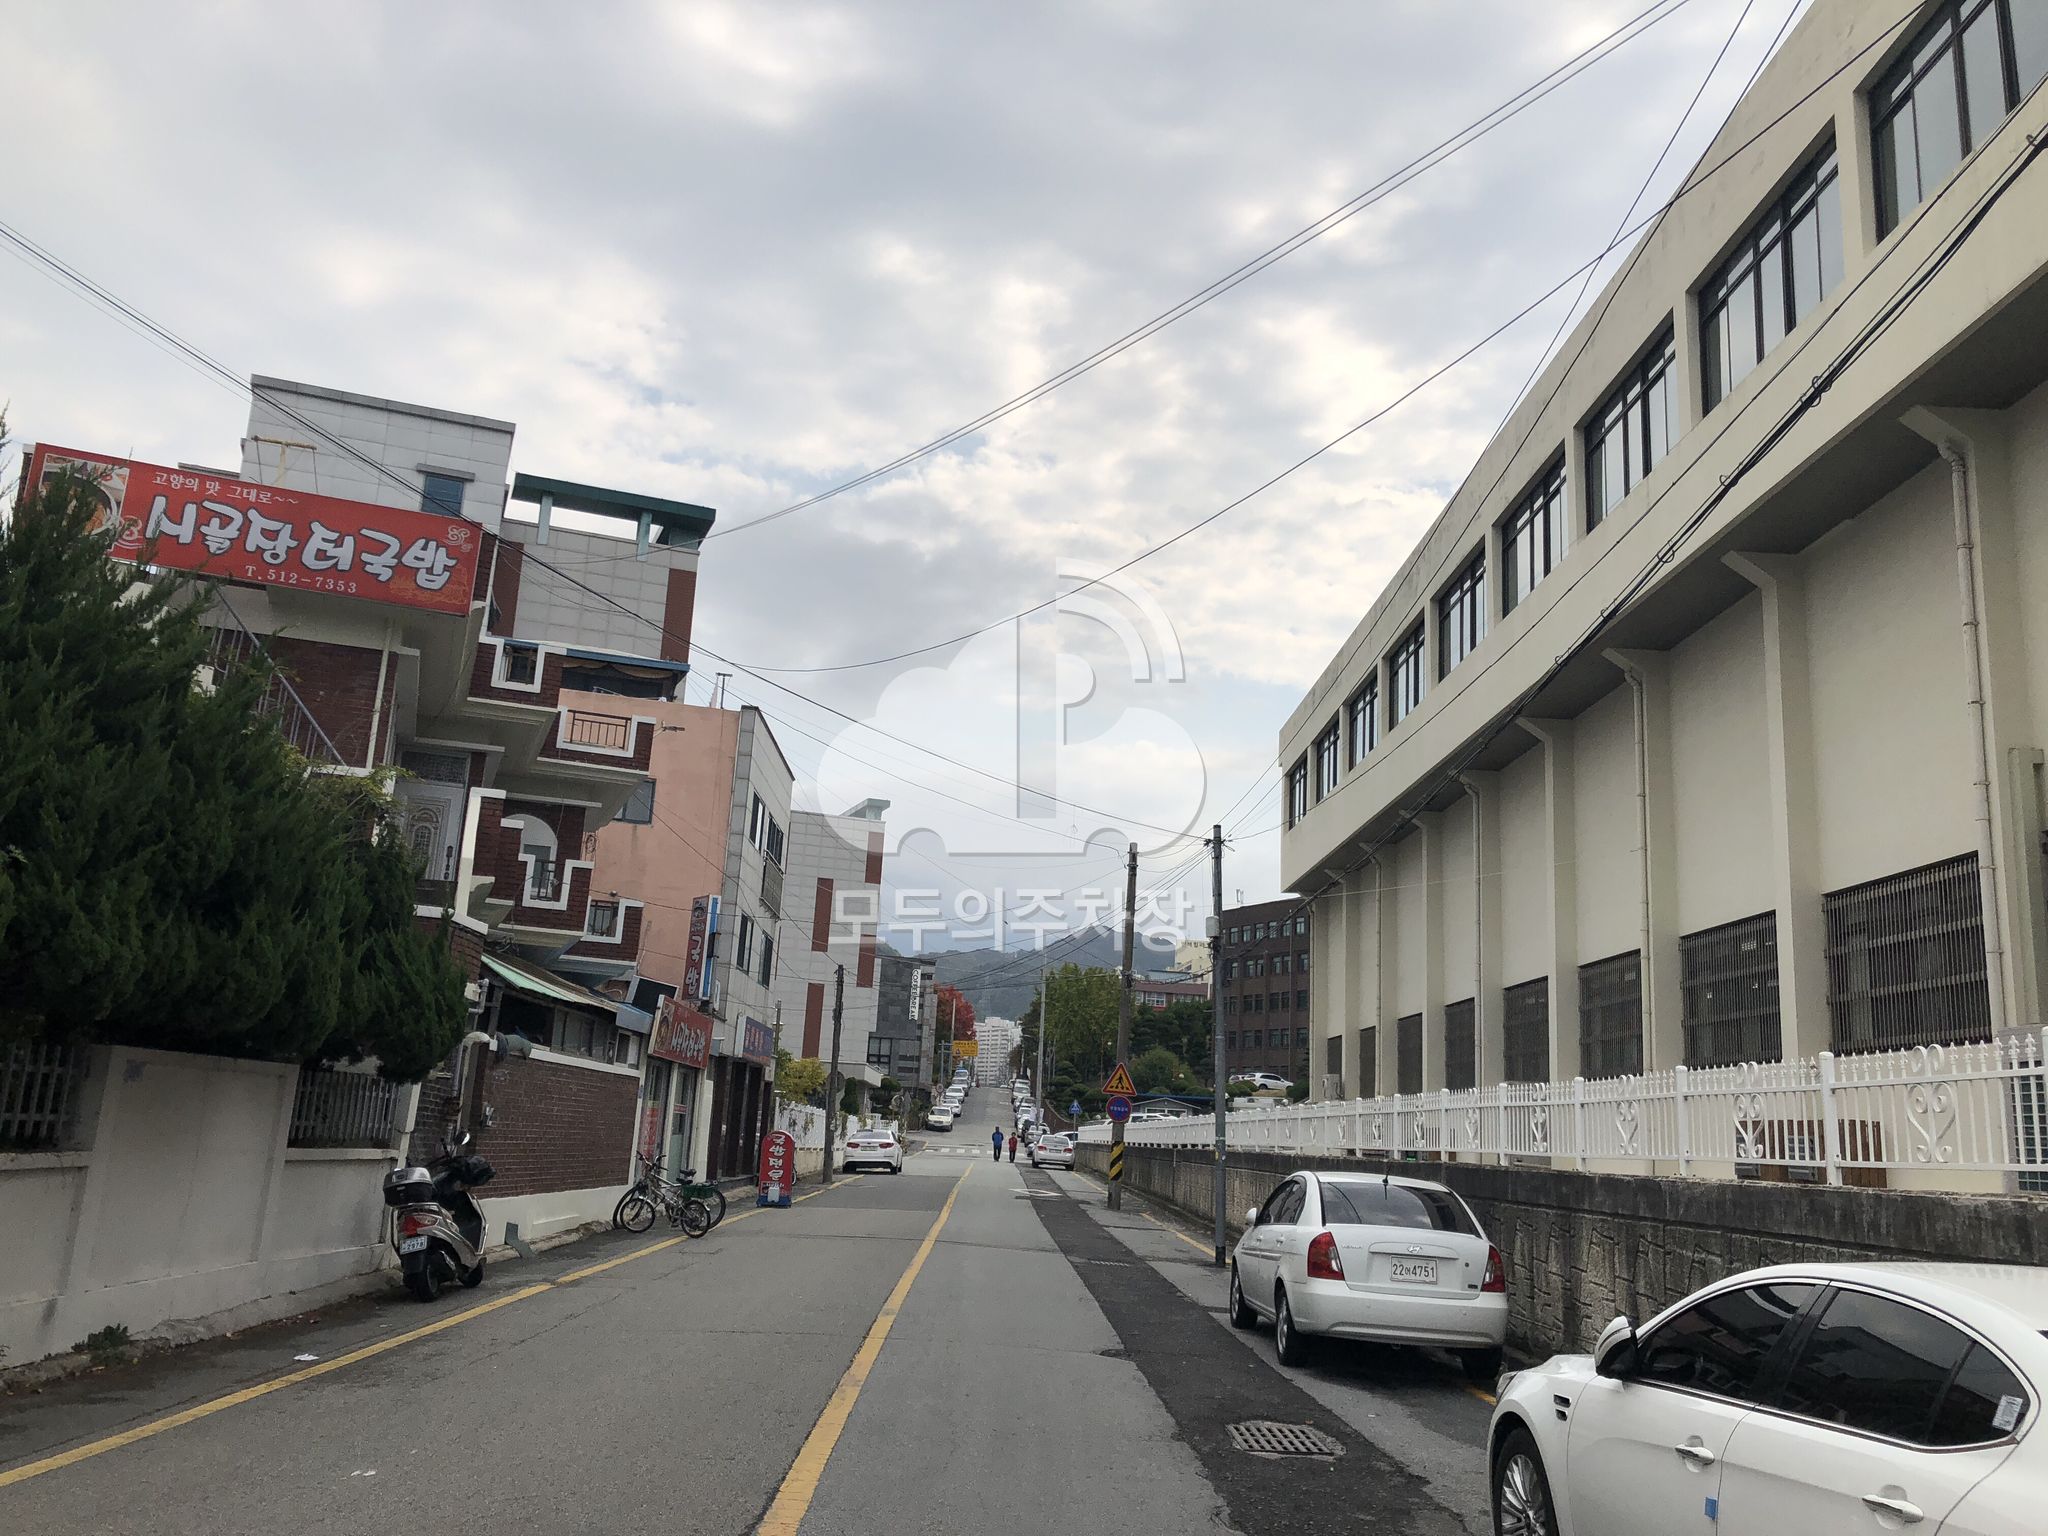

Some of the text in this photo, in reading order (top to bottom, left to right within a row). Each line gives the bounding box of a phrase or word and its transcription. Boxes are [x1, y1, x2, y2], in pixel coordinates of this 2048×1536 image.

[152, 471, 199, 492] 고향의
[205, 480, 221, 496] 맛
[145, 495, 457, 590] 시골장터국밥
[245, 564, 358, 594] T.512-7353
[1392, 1263, 1435, 1278] 22어4751
